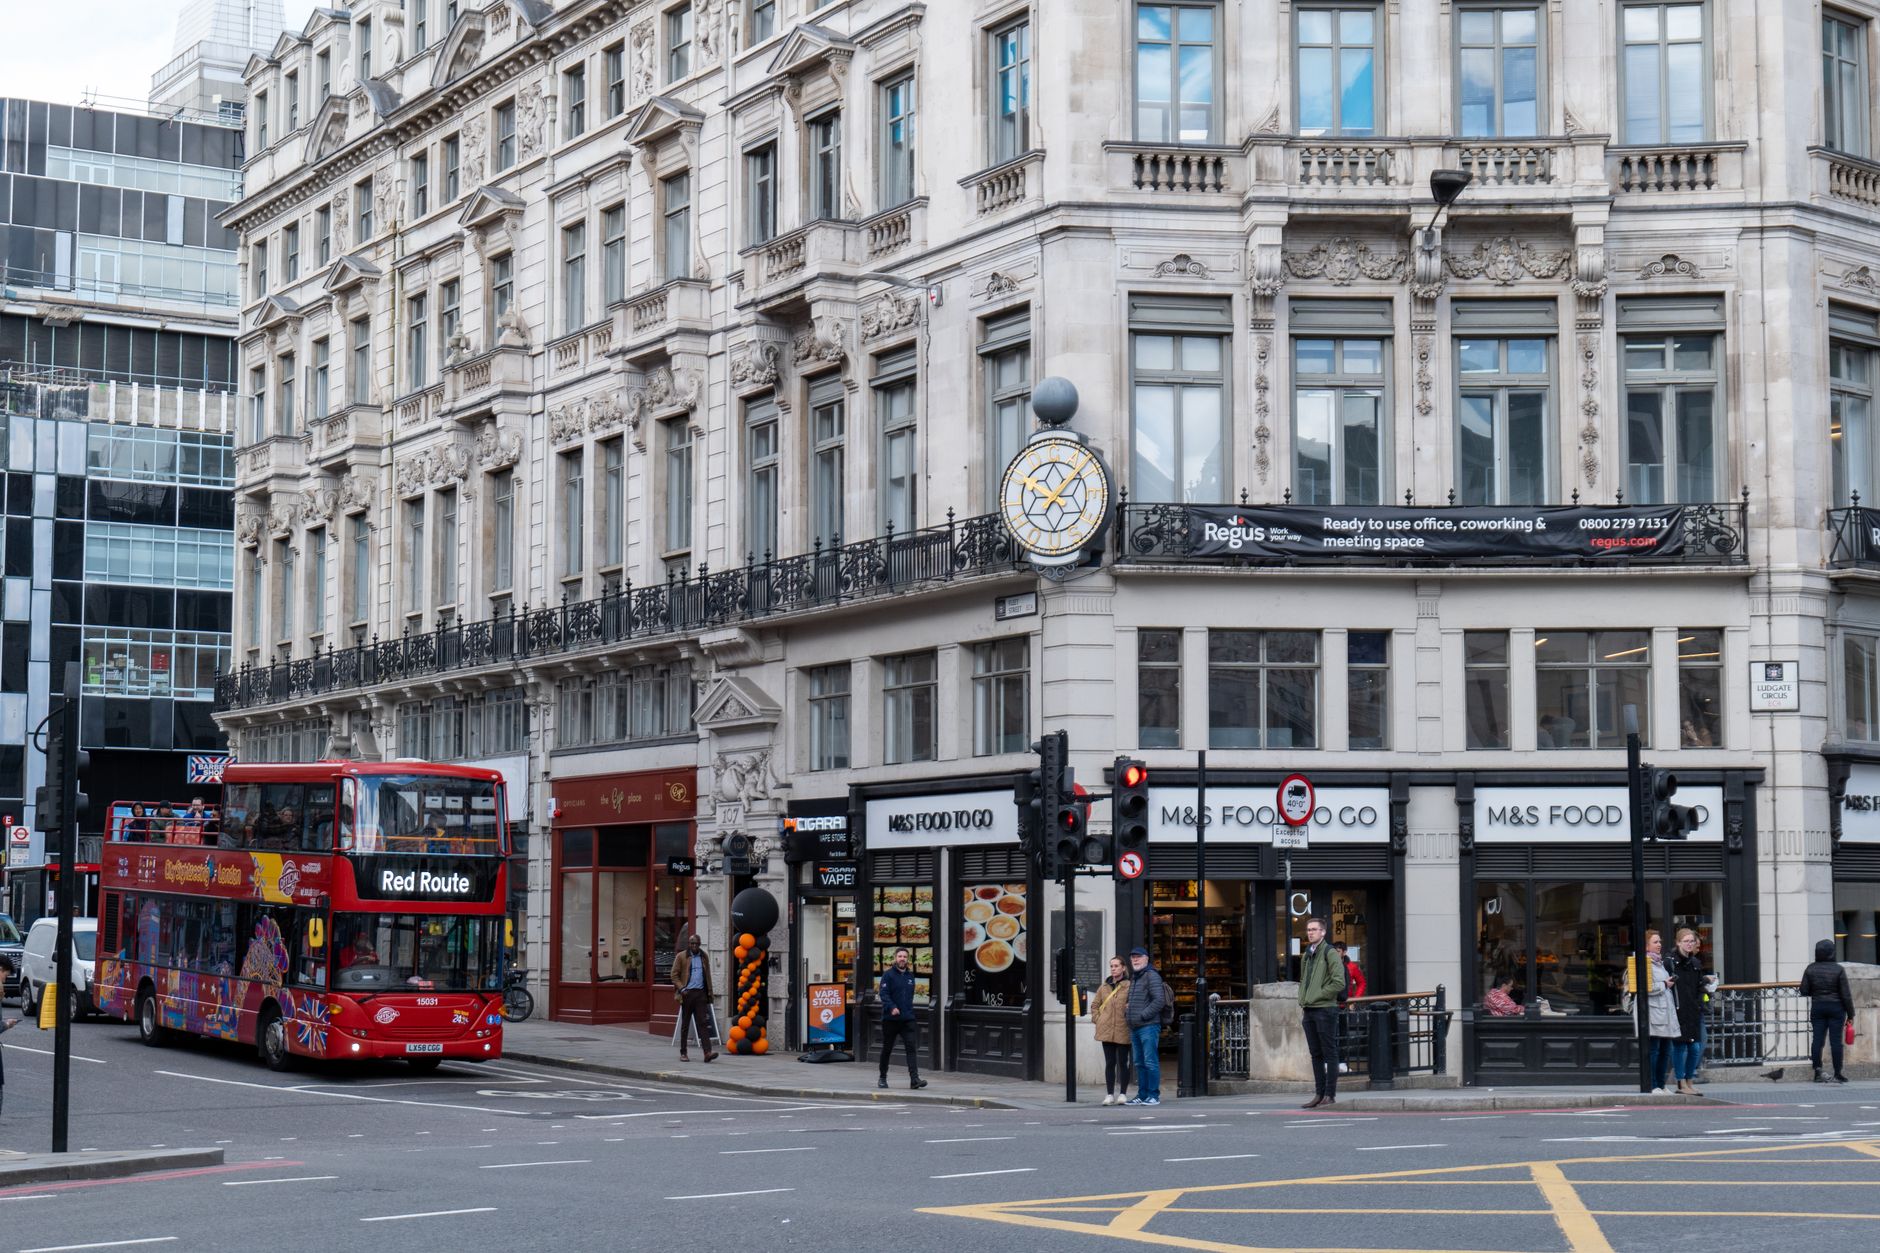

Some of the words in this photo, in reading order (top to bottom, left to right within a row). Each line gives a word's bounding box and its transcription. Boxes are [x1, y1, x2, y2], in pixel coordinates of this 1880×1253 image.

[1008, 508, 1097, 549] HOUSE
[1323, 517, 1367, 534] Ready
[1368, 518, 1383, 531] to
[1386, 520, 1411, 530] use
[1413, 517, 1458, 532] office,
[1460, 517, 1534, 532] coworking
[1535, 518, 1547, 530] &
[1579, 518, 1611, 530] 0800
[1612, 518, 1636, 530] 279
[1638, 517, 1669, 529] 7131
[1204, 519, 1265, 549] Regus
[1270, 527, 1289, 535] Work
[1287, 534, 1302, 542] way
[1323, 535, 1381, 550] meeting
[1384, 536, 1425, 550] space
[1591, 536, 1657, 549] regus.com
[1757, 684, 1792, 692] LUDGATE
[601, 794, 609, 805] the
[627, 792, 642, 806] place
[5, 815, 12, 824] E
[722, 808, 739, 824] 107
[888, 813, 914, 832] M&S
[916, 811, 952, 831] FOOD
[953, 810, 971, 828] TO
[972, 808, 994, 828] GO
[1222, 806, 1281, 825] FOO
[1339, 806, 1378, 825] GO
[1488, 805, 1539, 825] M&S
[1550, 805, 1623, 825] FOOD
[831, 833, 846, 841] STORE
[1275, 828, 1296, 837] Except
[1296, 828, 1306, 836] for
[672, 861, 691, 872] Regus
[218, 863, 242, 885] London
[821, 874, 852, 885] VAPE
[382, 870, 415, 891] Red
[420, 871, 470, 893] Route
[815, 989, 839, 998] VAPE
[982, 988, 1004, 1007] M&S
[417, 998, 438, 1006] 15031
[408, 1043, 426, 1052] LX58
